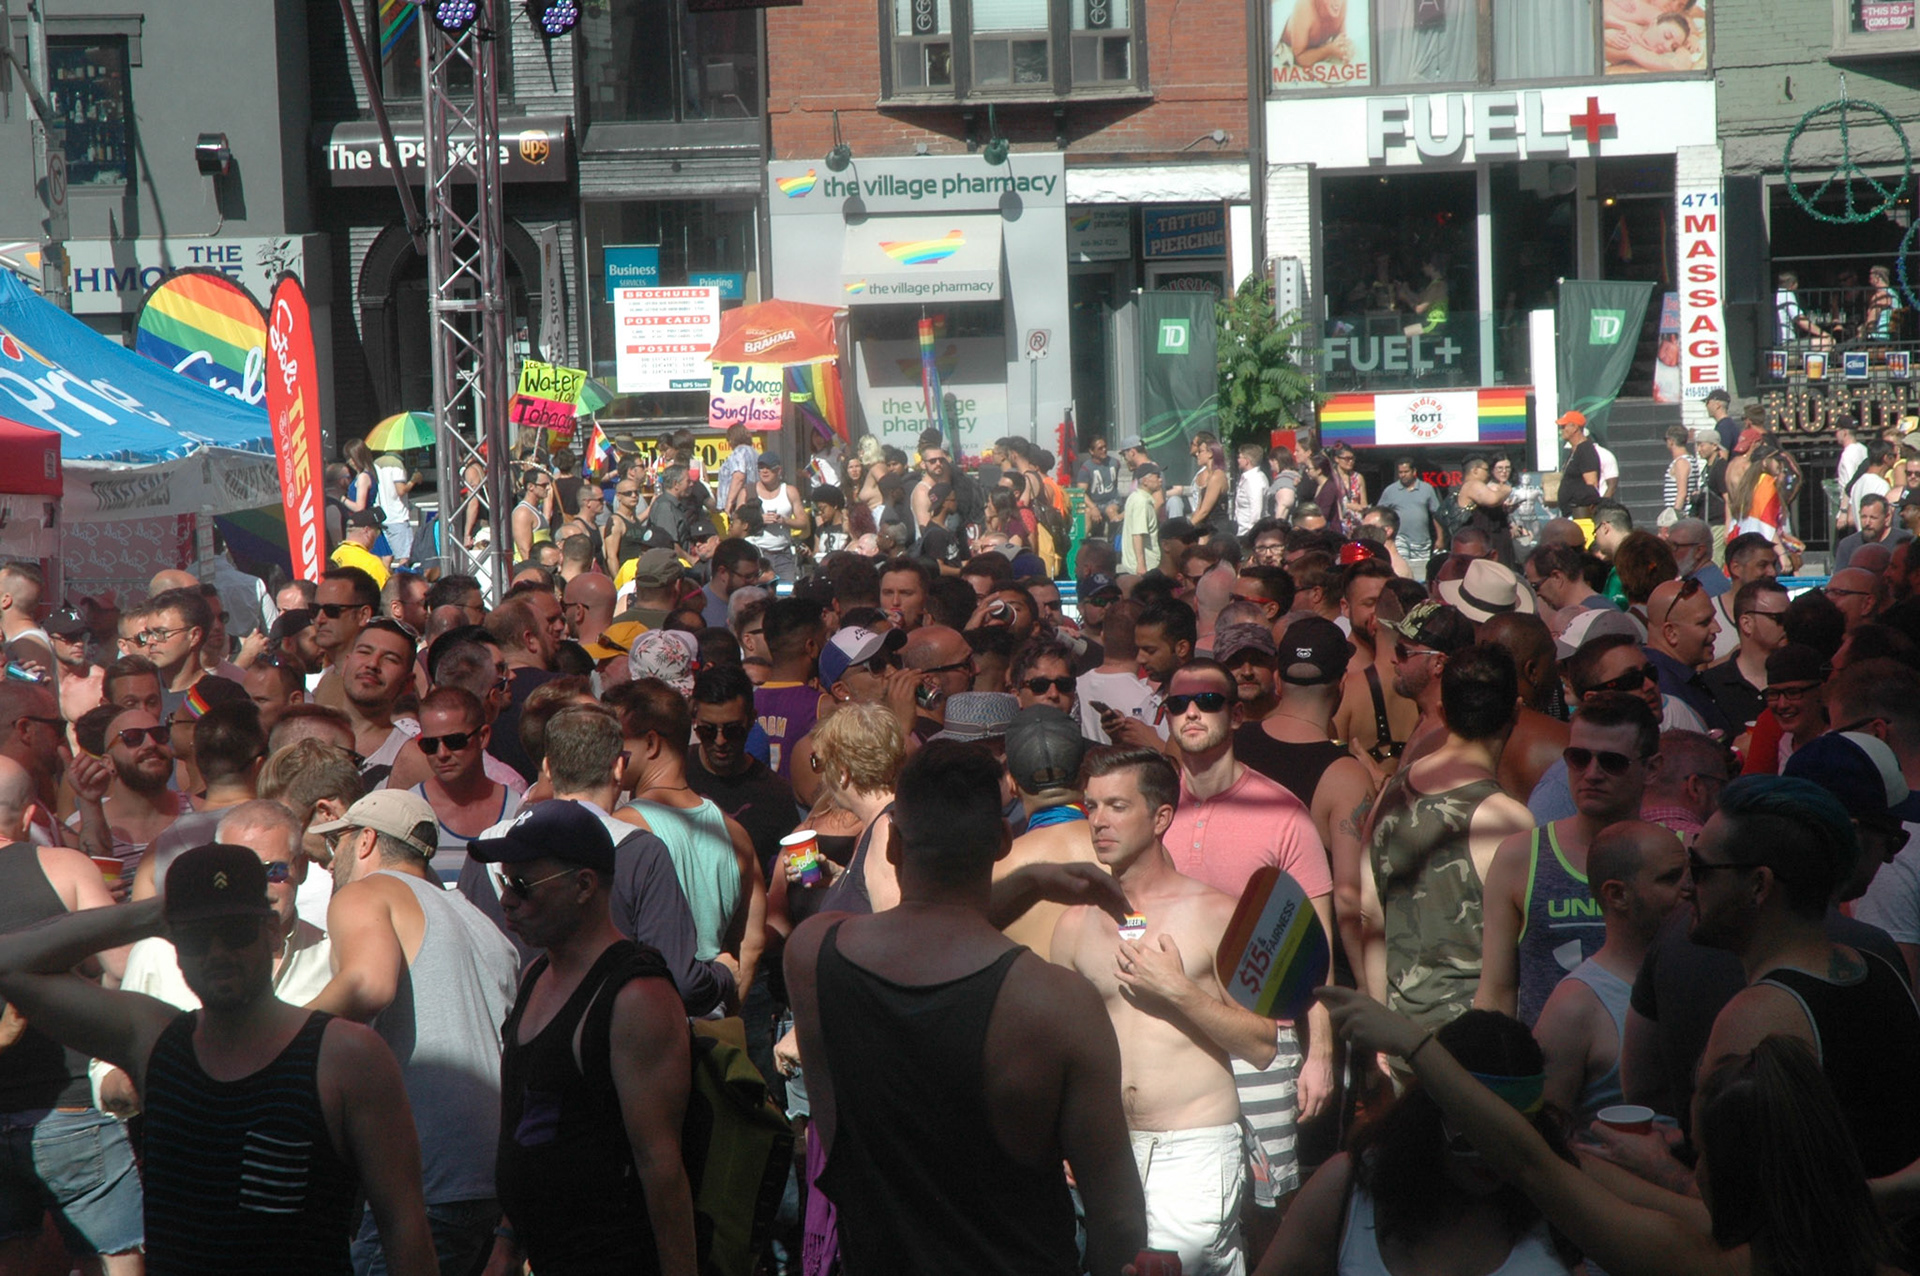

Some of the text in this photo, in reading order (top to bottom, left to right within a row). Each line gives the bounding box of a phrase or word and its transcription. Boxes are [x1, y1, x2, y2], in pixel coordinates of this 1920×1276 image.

[1272, 63, 1367, 83] MASSAGE
[323, 145, 372, 170] The
[448, 142, 510, 168] Stoe
[521, 138, 547, 161] ups
[824, 173, 1057, 200] the village pharmacy
[1682, 193, 1720, 208] 471
[1157, 210, 1216, 232] TATTOO
[1150, 230, 1224, 255] PIERCING
[188, 245, 243, 263] THE
[609, 264, 656, 276] Business
[626, 289, 706, 298] BROCHURES
[699, 278, 734, 289] Printing
[869, 281, 994, 296] the village pharmacy
[1684, 214, 1720, 384] MASSAGE
[626, 315, 710, 325] POST CARDS
[1597, 315, 1622, 339] TD
[744, 330, 796, 353] BRAHMA
[1162, 326, 1186, 348] TD
[638, 345, 697, 353] POSTERS
[524, 369, 580, 393] Water
[720, 365, 782, 394] Tobacco
[882, 398, 912, 415] the
[1408, 397, 1443, 412] Indian
[1769, 386, 1908, 433] NORTH
[1411, 413, 1442, 423] ROTI
[1410, 422, 1444, 438] House
[1265, 899, 1296, 956] FAIRNESS
